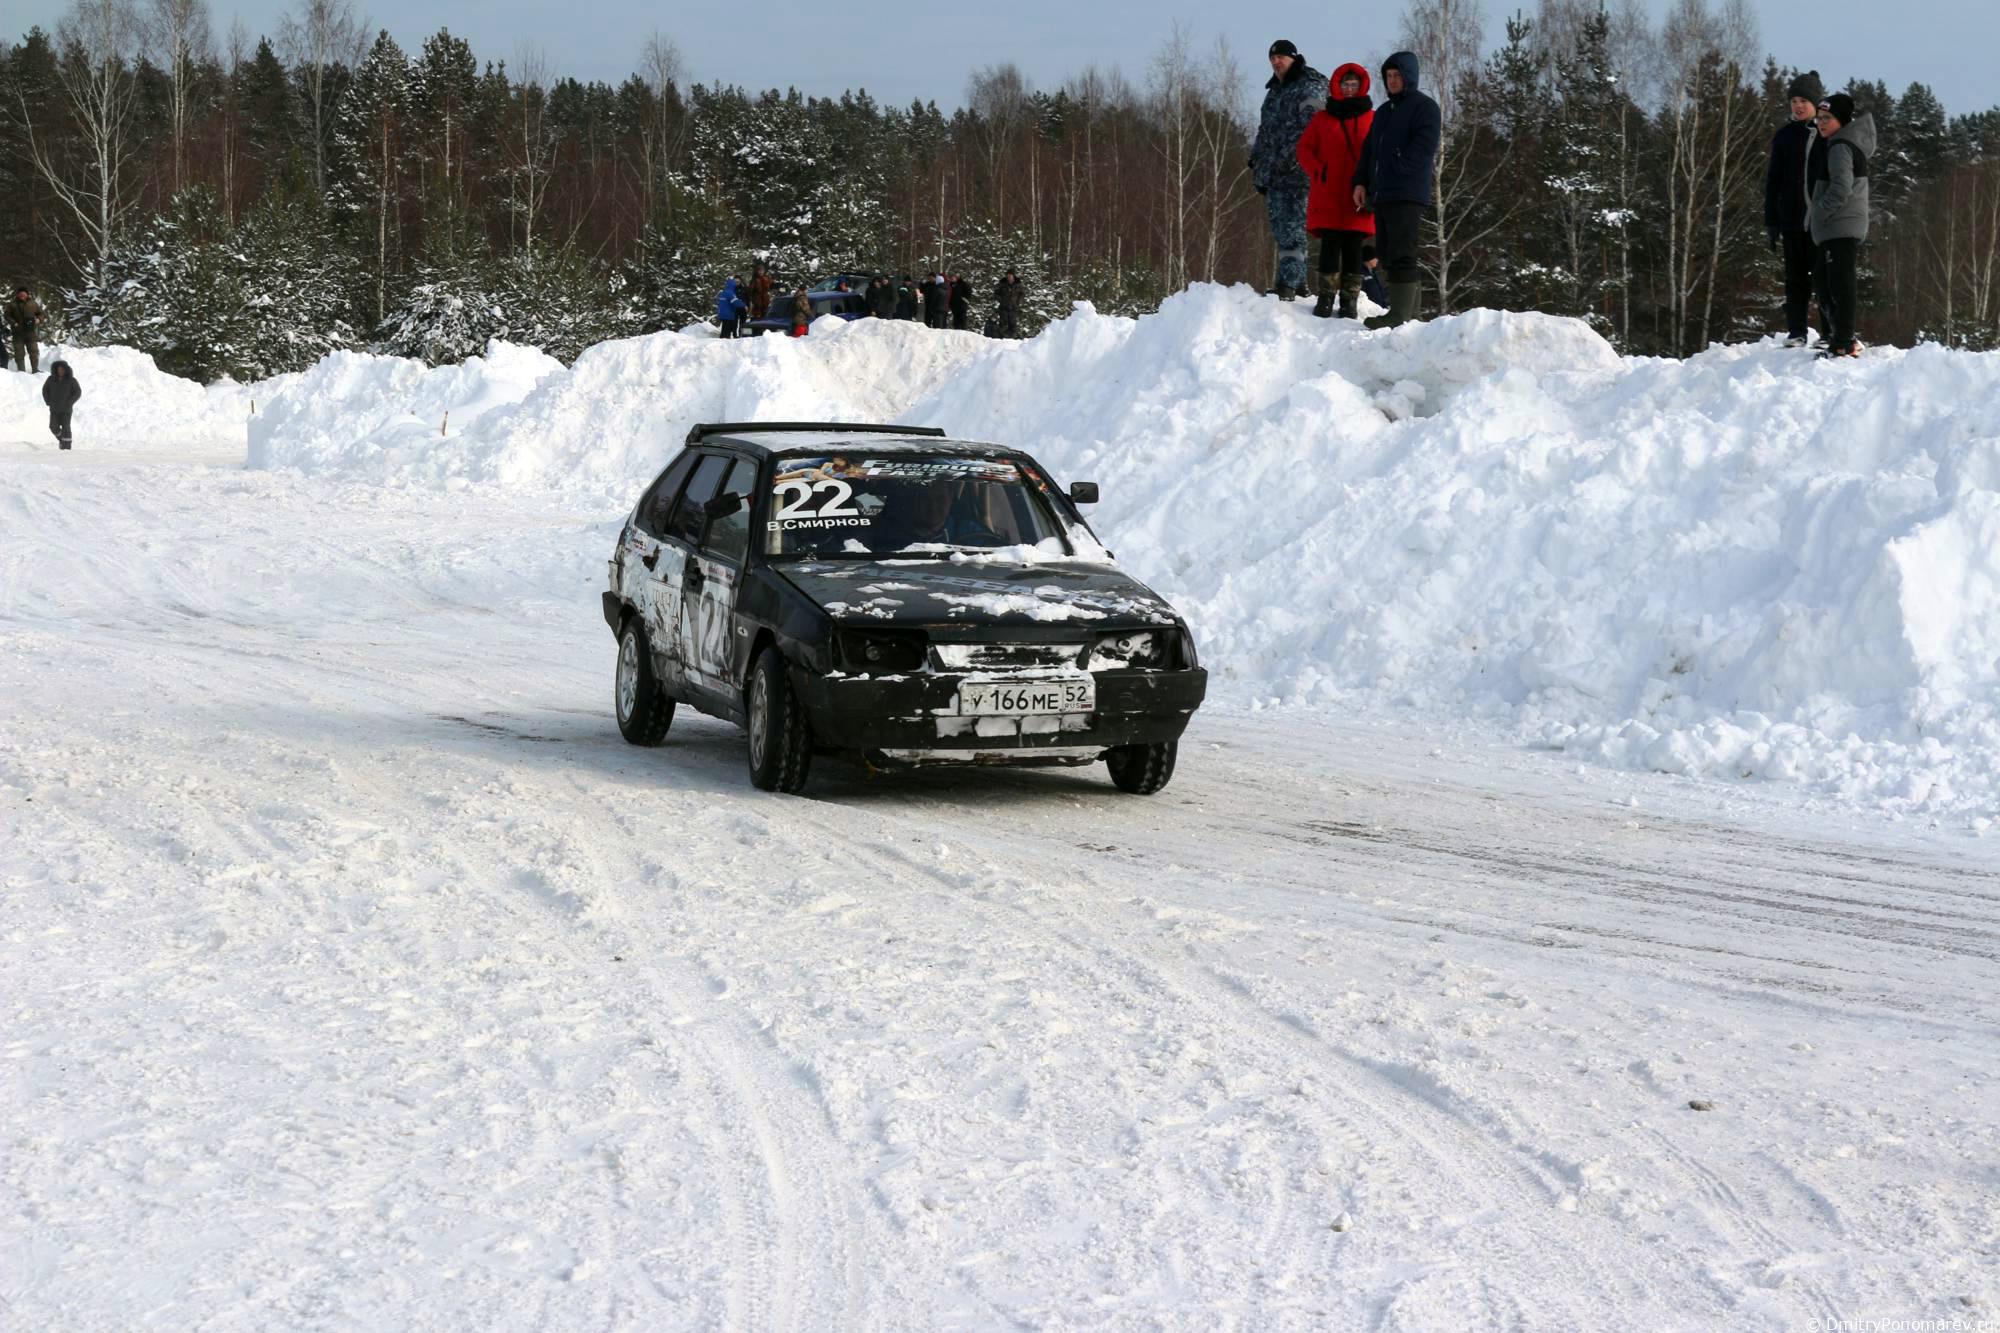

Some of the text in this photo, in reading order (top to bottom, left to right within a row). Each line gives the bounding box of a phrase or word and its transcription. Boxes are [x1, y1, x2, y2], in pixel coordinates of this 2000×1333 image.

[772, 479, 860, 521] 22
[766, 518, 872, 532] В.Смирнов
[1065, 686, 1087, 702] 52
